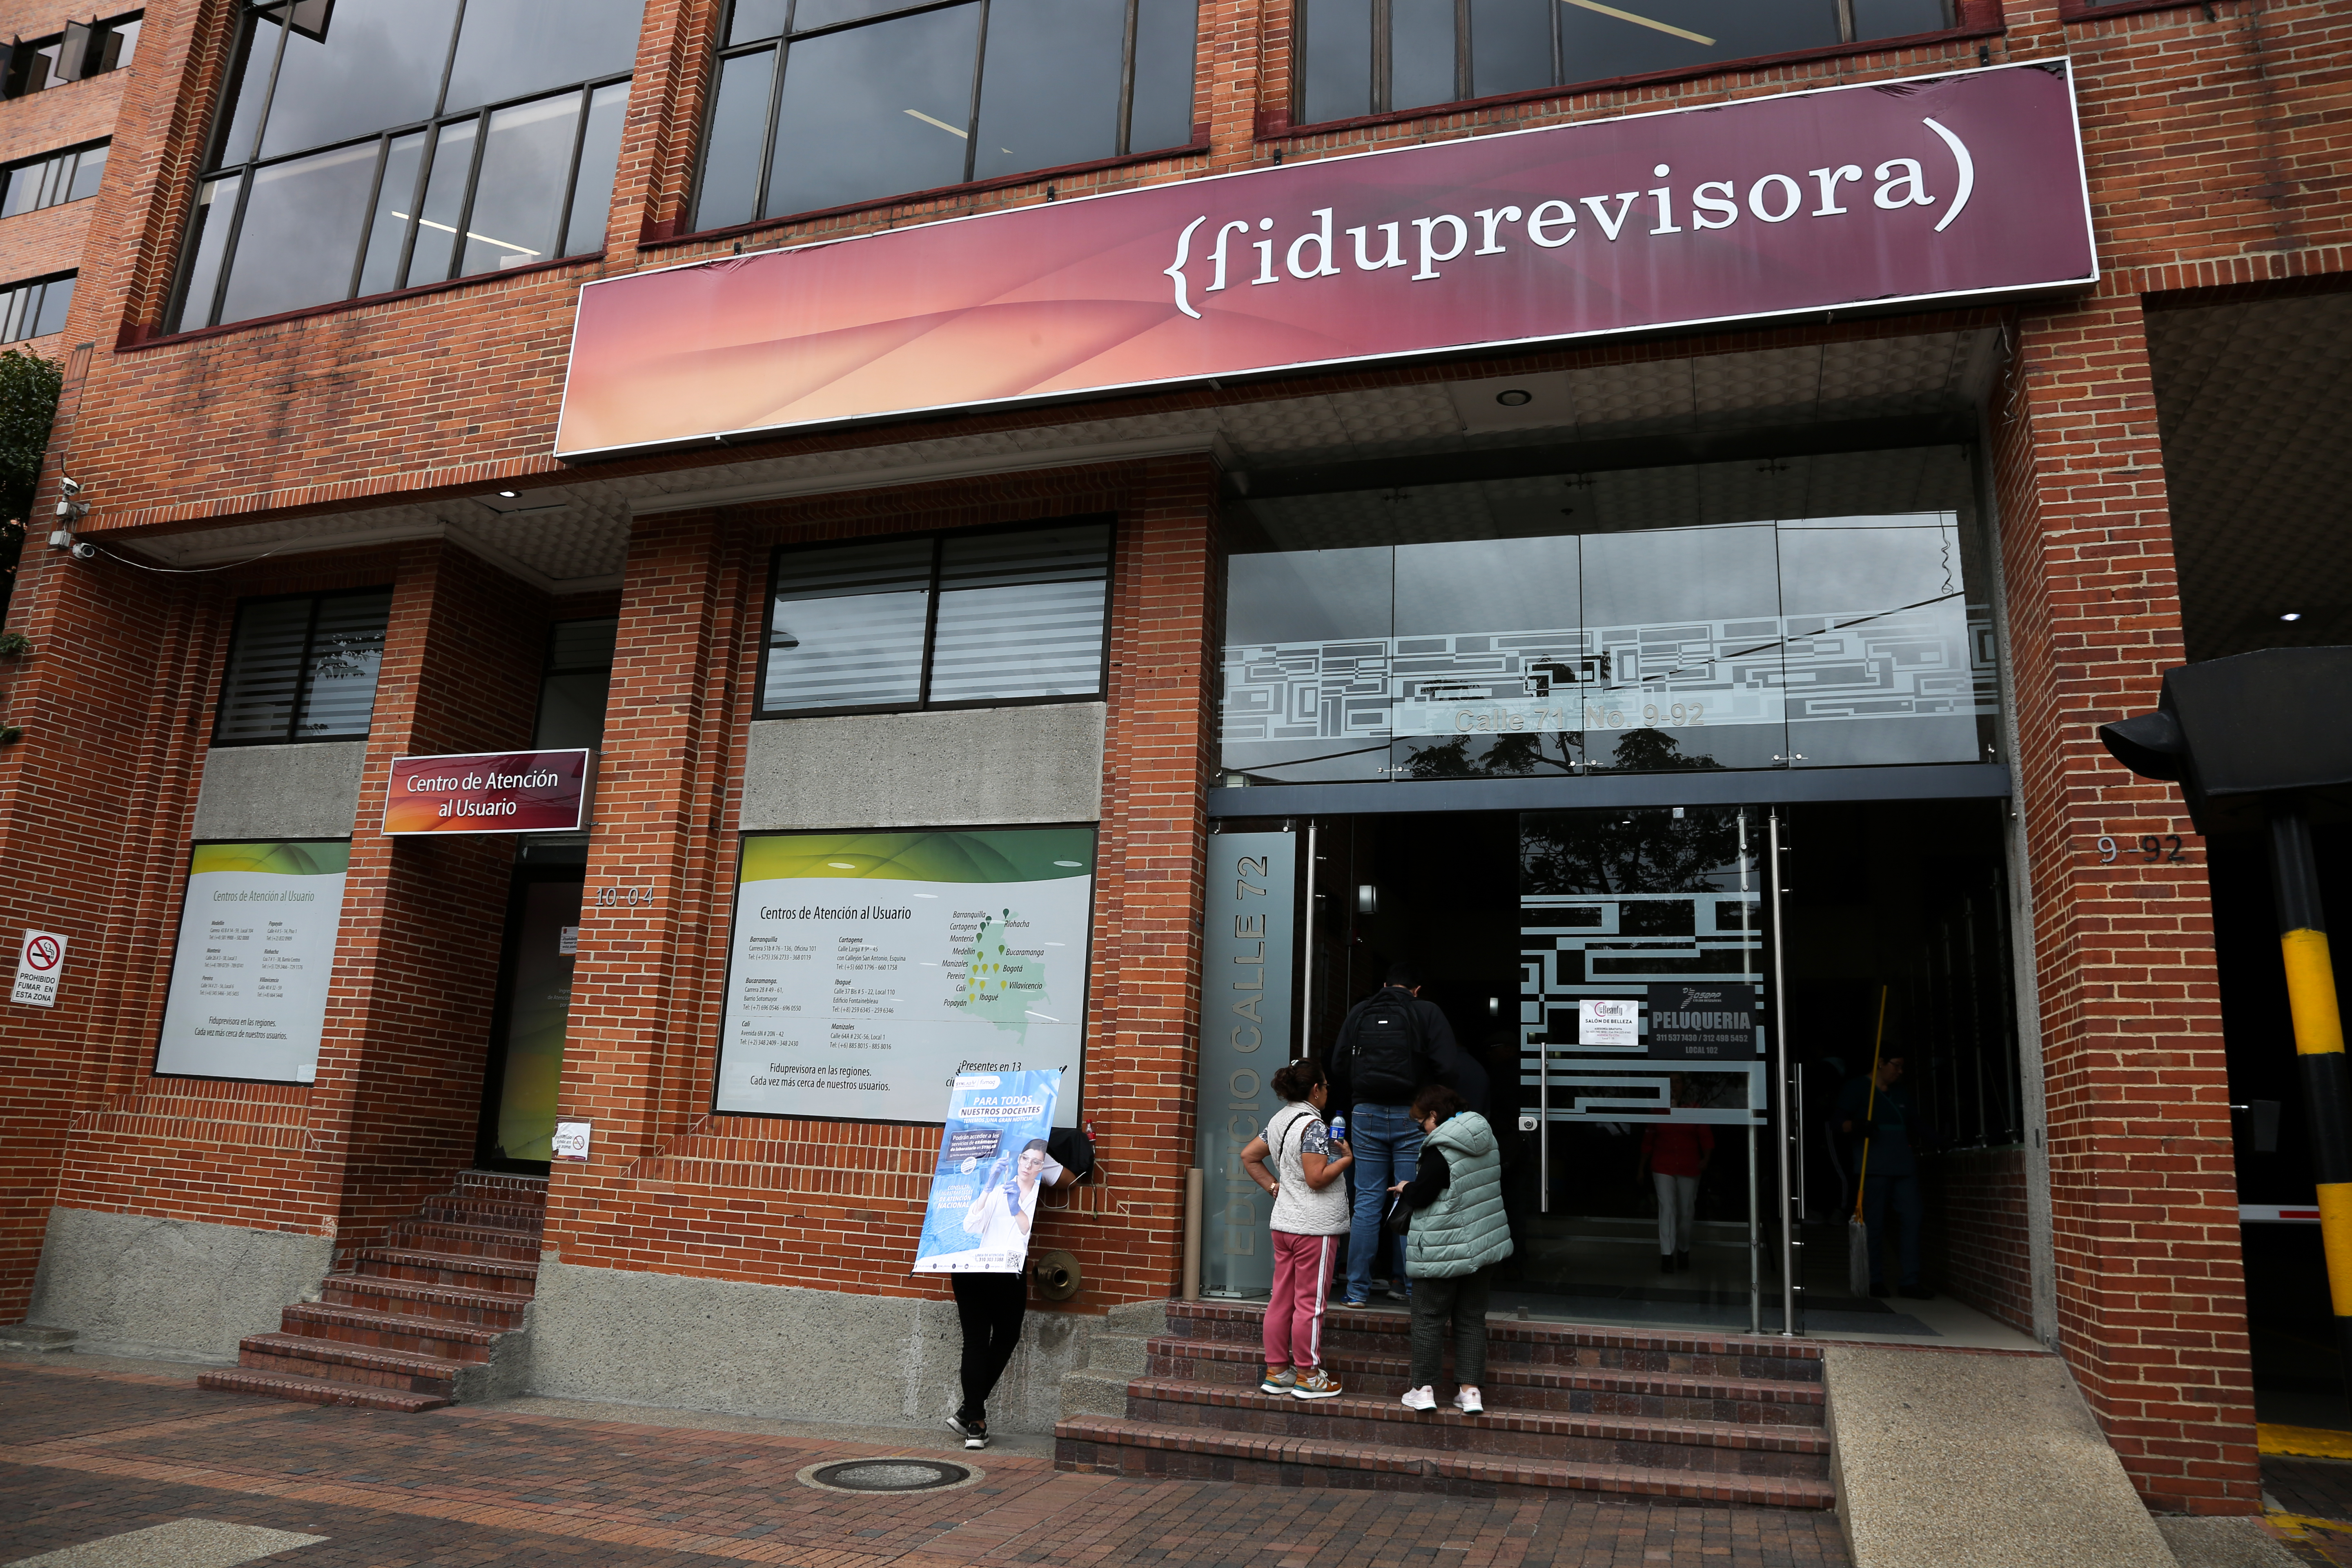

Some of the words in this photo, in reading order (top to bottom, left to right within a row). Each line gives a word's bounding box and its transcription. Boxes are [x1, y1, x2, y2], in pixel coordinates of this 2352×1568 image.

[1455, 709, 1523, 731] Calle
[1535, 708, 1564, 729] 71
[1586, 706, 1631, 728] No.
[1643, 703, 1704, 726] 9-92
[407, 775, 458, 792] Centro
[462, 772, 481, 790] de
[485, 769, 558, 790] Atención
[439, 799, 452, 817] al
[457, 798, 517, 816] Usuario
[1237, 855, 1267, 900] 72
[214, 891, 238, 901] Centros
[239, 891, 247, 901] de
[249, 890, 278, 901] Atención
[280, 890, 286, 901] al
[288, 891, 314, 901] Usuario
[761, 906, 796, 919] Centros
[799, 906, 811, 919] de
[813, 906, 858, 919] Atención
[860, 906, 870, 919] al
[873, 906, 911, 919] Usuario
[953, 911, 986, 919] Barranquilla
[950, 923, 977, 931] Cartagena
[1006, 949, 1044, 958] Bucaramanga
[1003, 965, 1023, 973] Bogotá
[20, 973, 55, 984] PROHIBIDO
[1231, 914, 1265, 1053] CALLE
[18, 982, 41, 991] FUMAR
[16, 991, 31, 999] ESTA
[33, 993, 51, 1002] ZONA
[979, 993, 999, 1002] Ibagué
[944, 999, 967, 1008] Popayán
[1603, 1005, 1622, 1016] Beauty
[209, 1016, 240, 1026] Fiduprevisora
[255, 1019, 276, 1028] regiones.
[1653, 1011, 1751, 1030] PELUQUERIA
[238, 1029, 245, 1038] de
[770, 1063, 816, 1075] Fiduprevisora
[828, 1065, 837, 1075] las
[840, 1066, 872, 1078] regiones.
[959, 1060, 998, 1071] ¡Presentes
[1011, 1062, 1021, 1071] 13
[751, 1076, 766, 1085] Cada
[781, 1077, 795, 1087] más
[797, 1079, 815, 1087] cerca
[816, 1078, 825, 1088] de
[827, 1080, 857, 1089] nuestros
[858, 1081, 891, 1091] usuarios.
[973, 1097, 998, 1105] PARA
[1001, 1096, 1033, 1105] TODOS
[1001, 1106, 1040, 1115] DOCENTES
